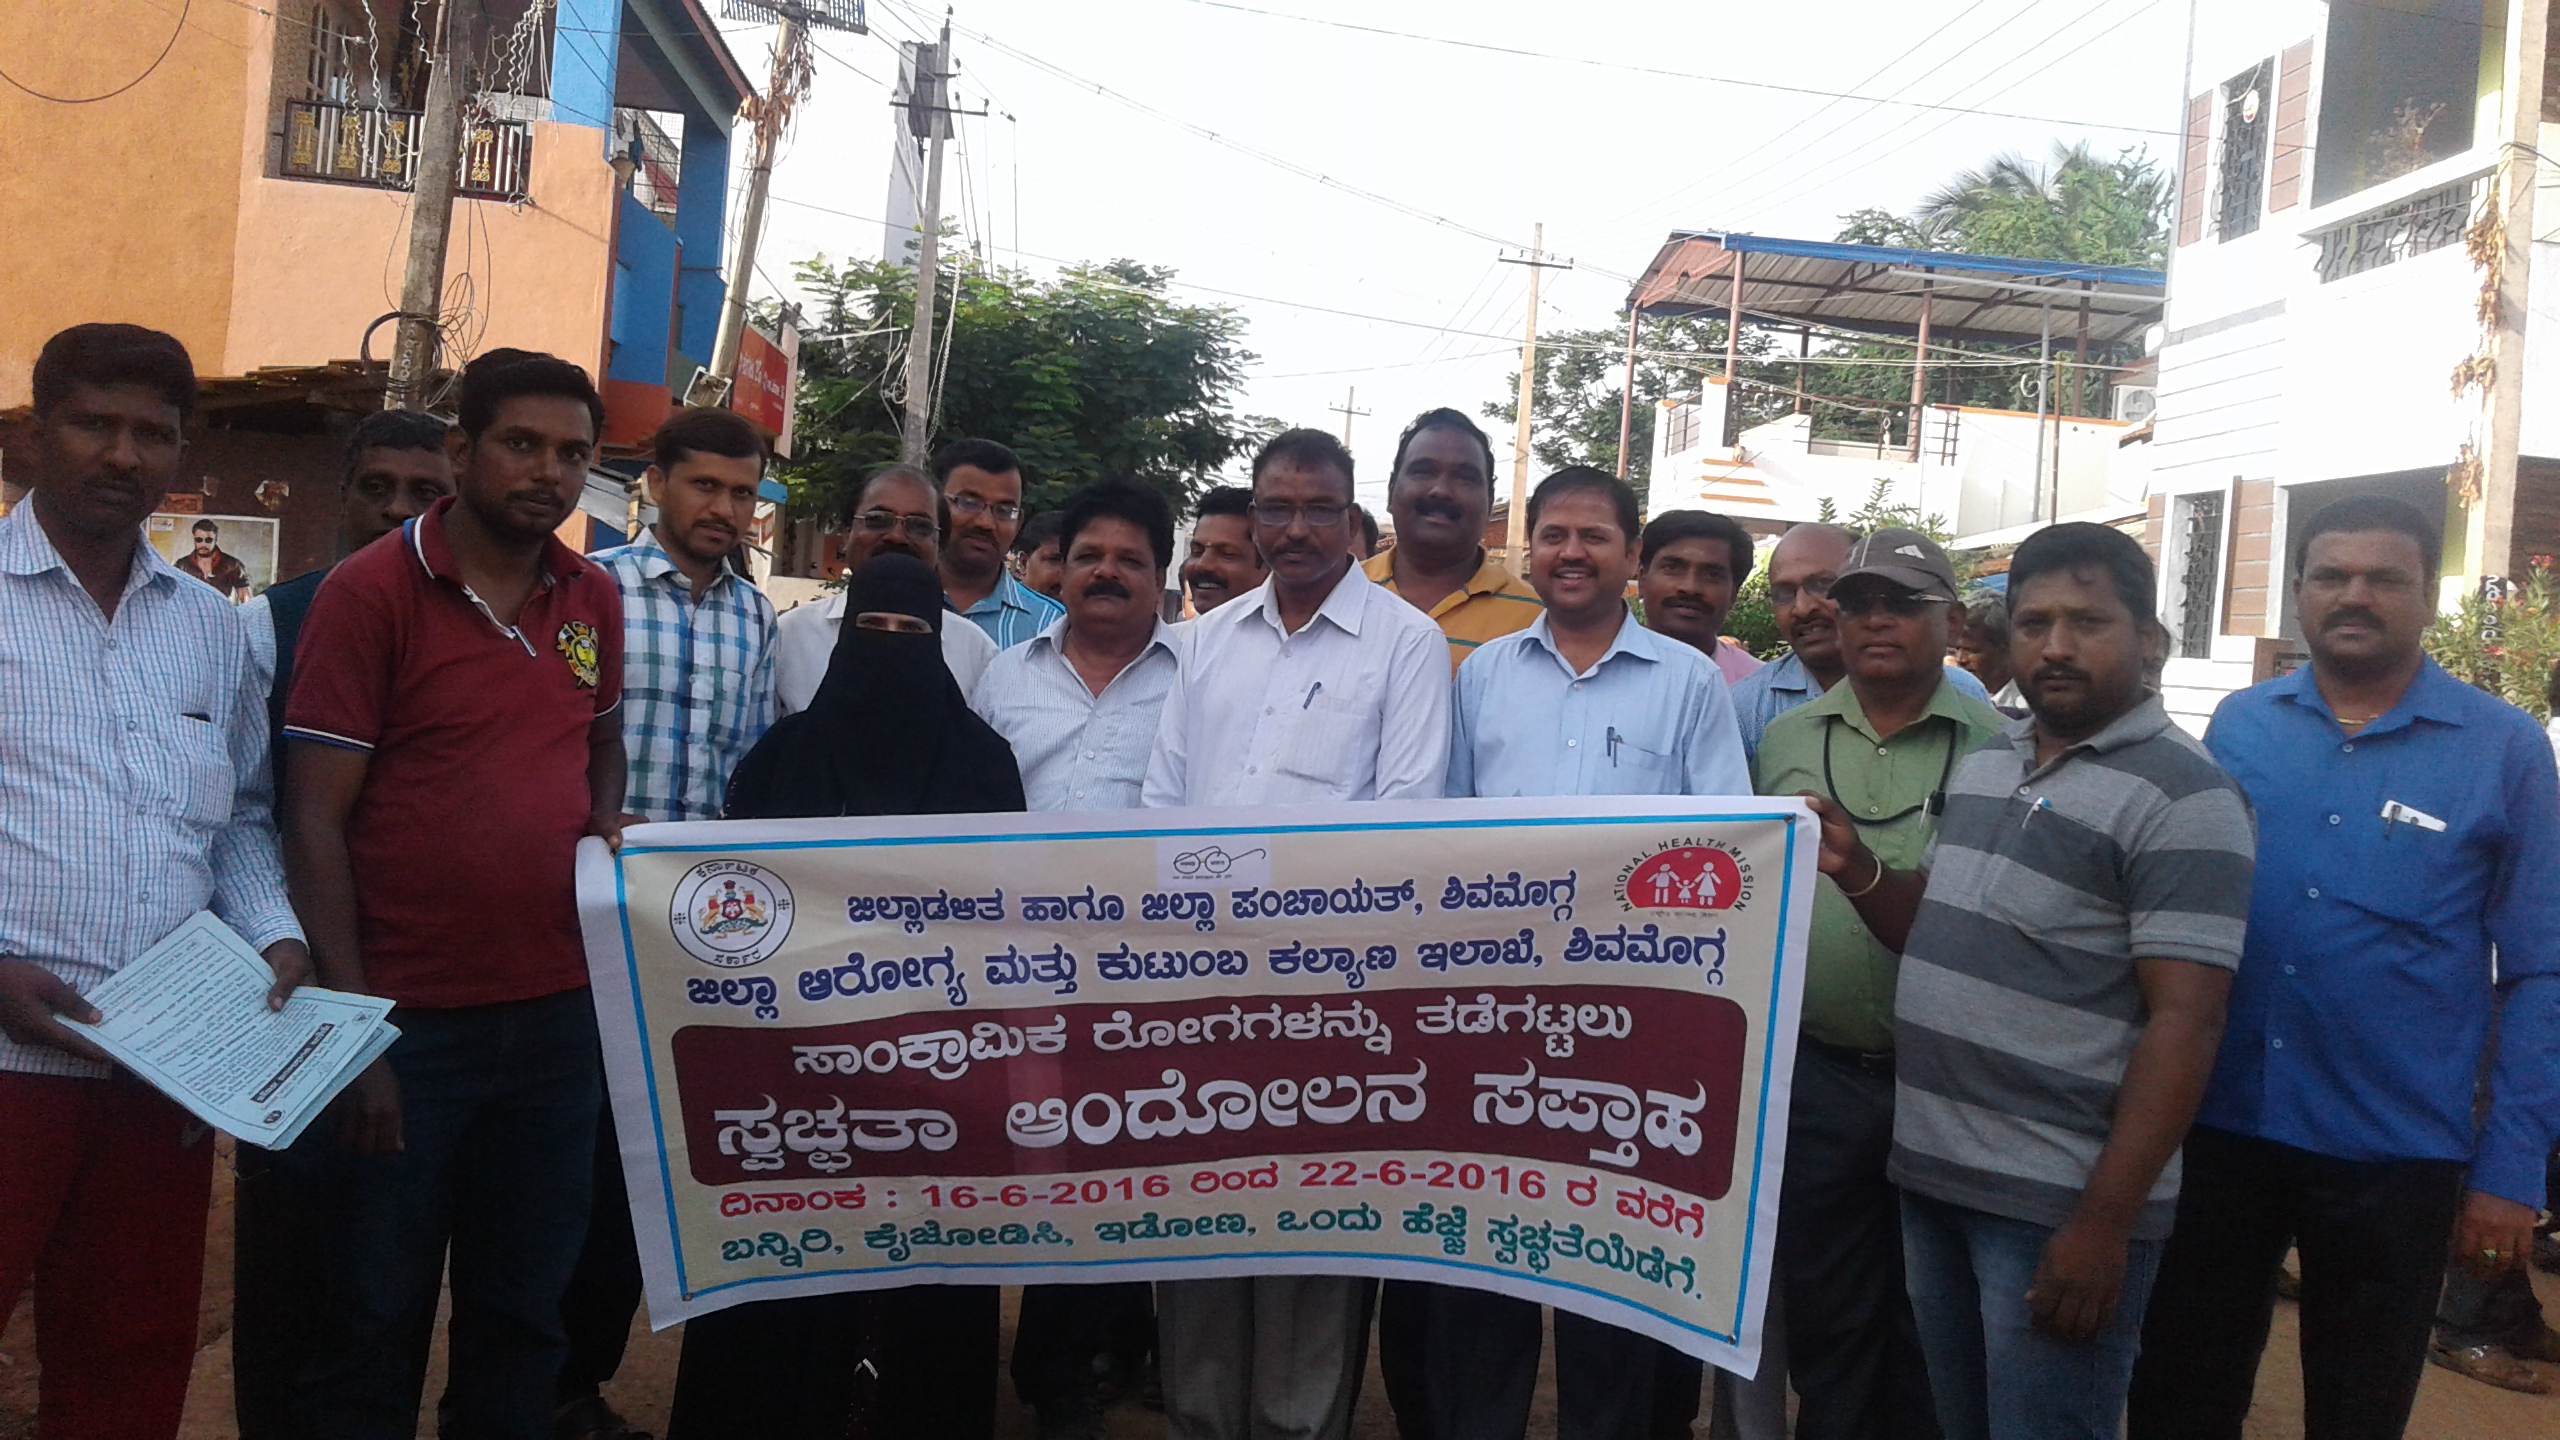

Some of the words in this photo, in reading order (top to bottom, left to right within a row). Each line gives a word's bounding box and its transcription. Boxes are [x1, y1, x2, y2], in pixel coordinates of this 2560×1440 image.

[696, 863, 760, 878] ಕರ್ನಾಟಕ
[848, 888, 1005, 934] ಜಿಲ್ಲಾಡಳಿತ
[1021, 885, 1125, 922] ಹಾಗೂ
[1141, 891, 1216, 932] ಜಿಲ್ಲಾ
[1231, 877, 1423, 919] ಪಂಚಾಯತ್,
[1440, 870, 1577, 923] ಶಿವಮೊಗ್ಗ
[1614, 851, 1652, 912] NATIONAL
[1658, 837, 1726, 852] HEALTH
[1728, 847, 1754, 912] MISSION
[686, 976, 780, 1020] ಜಿಲ್ಲಾ
[798, 945, 968, 1007] ಆರೋಗ್ಯ
[985, 942, 1078, 995] ಮತ್ತು
[1097, 941, 1249, 981] ಕುಟುಂಬ
[1268, 940, 1397, 990] ಕಲ್ಯಾಣ
[1417, 928, 1543, 973] ಇಲಾಖೆ,
[1563, 924, 1727, 986] ಶಿವಮೊಗ್ಗ
[792, 1014, 1067, 1080] ಸಾಂಕ್ರಾಮಿಕ
[1092, 1000, 1393, 1055] ರೋಗಗಳನ್ನು
[1416, 993, 1633, 1058] ತಡೆಗಟ್ಟಲು
[1006, 1057, 1428, 1149] ಆಂದೋಲನ
[1472, 1057, 1707, 1168] ಸಪ್ತಾಹ
[720, 1183, 867, 1217] ದಿನಾಂಕ
[921, 1174, 1170, 1208] 16-6-2016
[1190, 1161, 1279, 1193] ರಿಂದ
[1300, 1160, 1546, 1199] 22-6-2016
[1566, 1175, 1598, 1207] ರ
[1616, 1186, 1705, 1239] ವರೆಗೆ
[721, 1229, 845, 1268] ಬನ್ನಿರಿ,
[863, 1219, 1075, 1263] ಕೈಜೋಡಿಸಿ,
[1094, 1212, 1257, 1244] ಇಡೋಣ,
[1276, 1201, 1383, 1232] ಒಂದು
[1402, 1202, 1468, 1256] ಹೆಜ್ಜೆ
